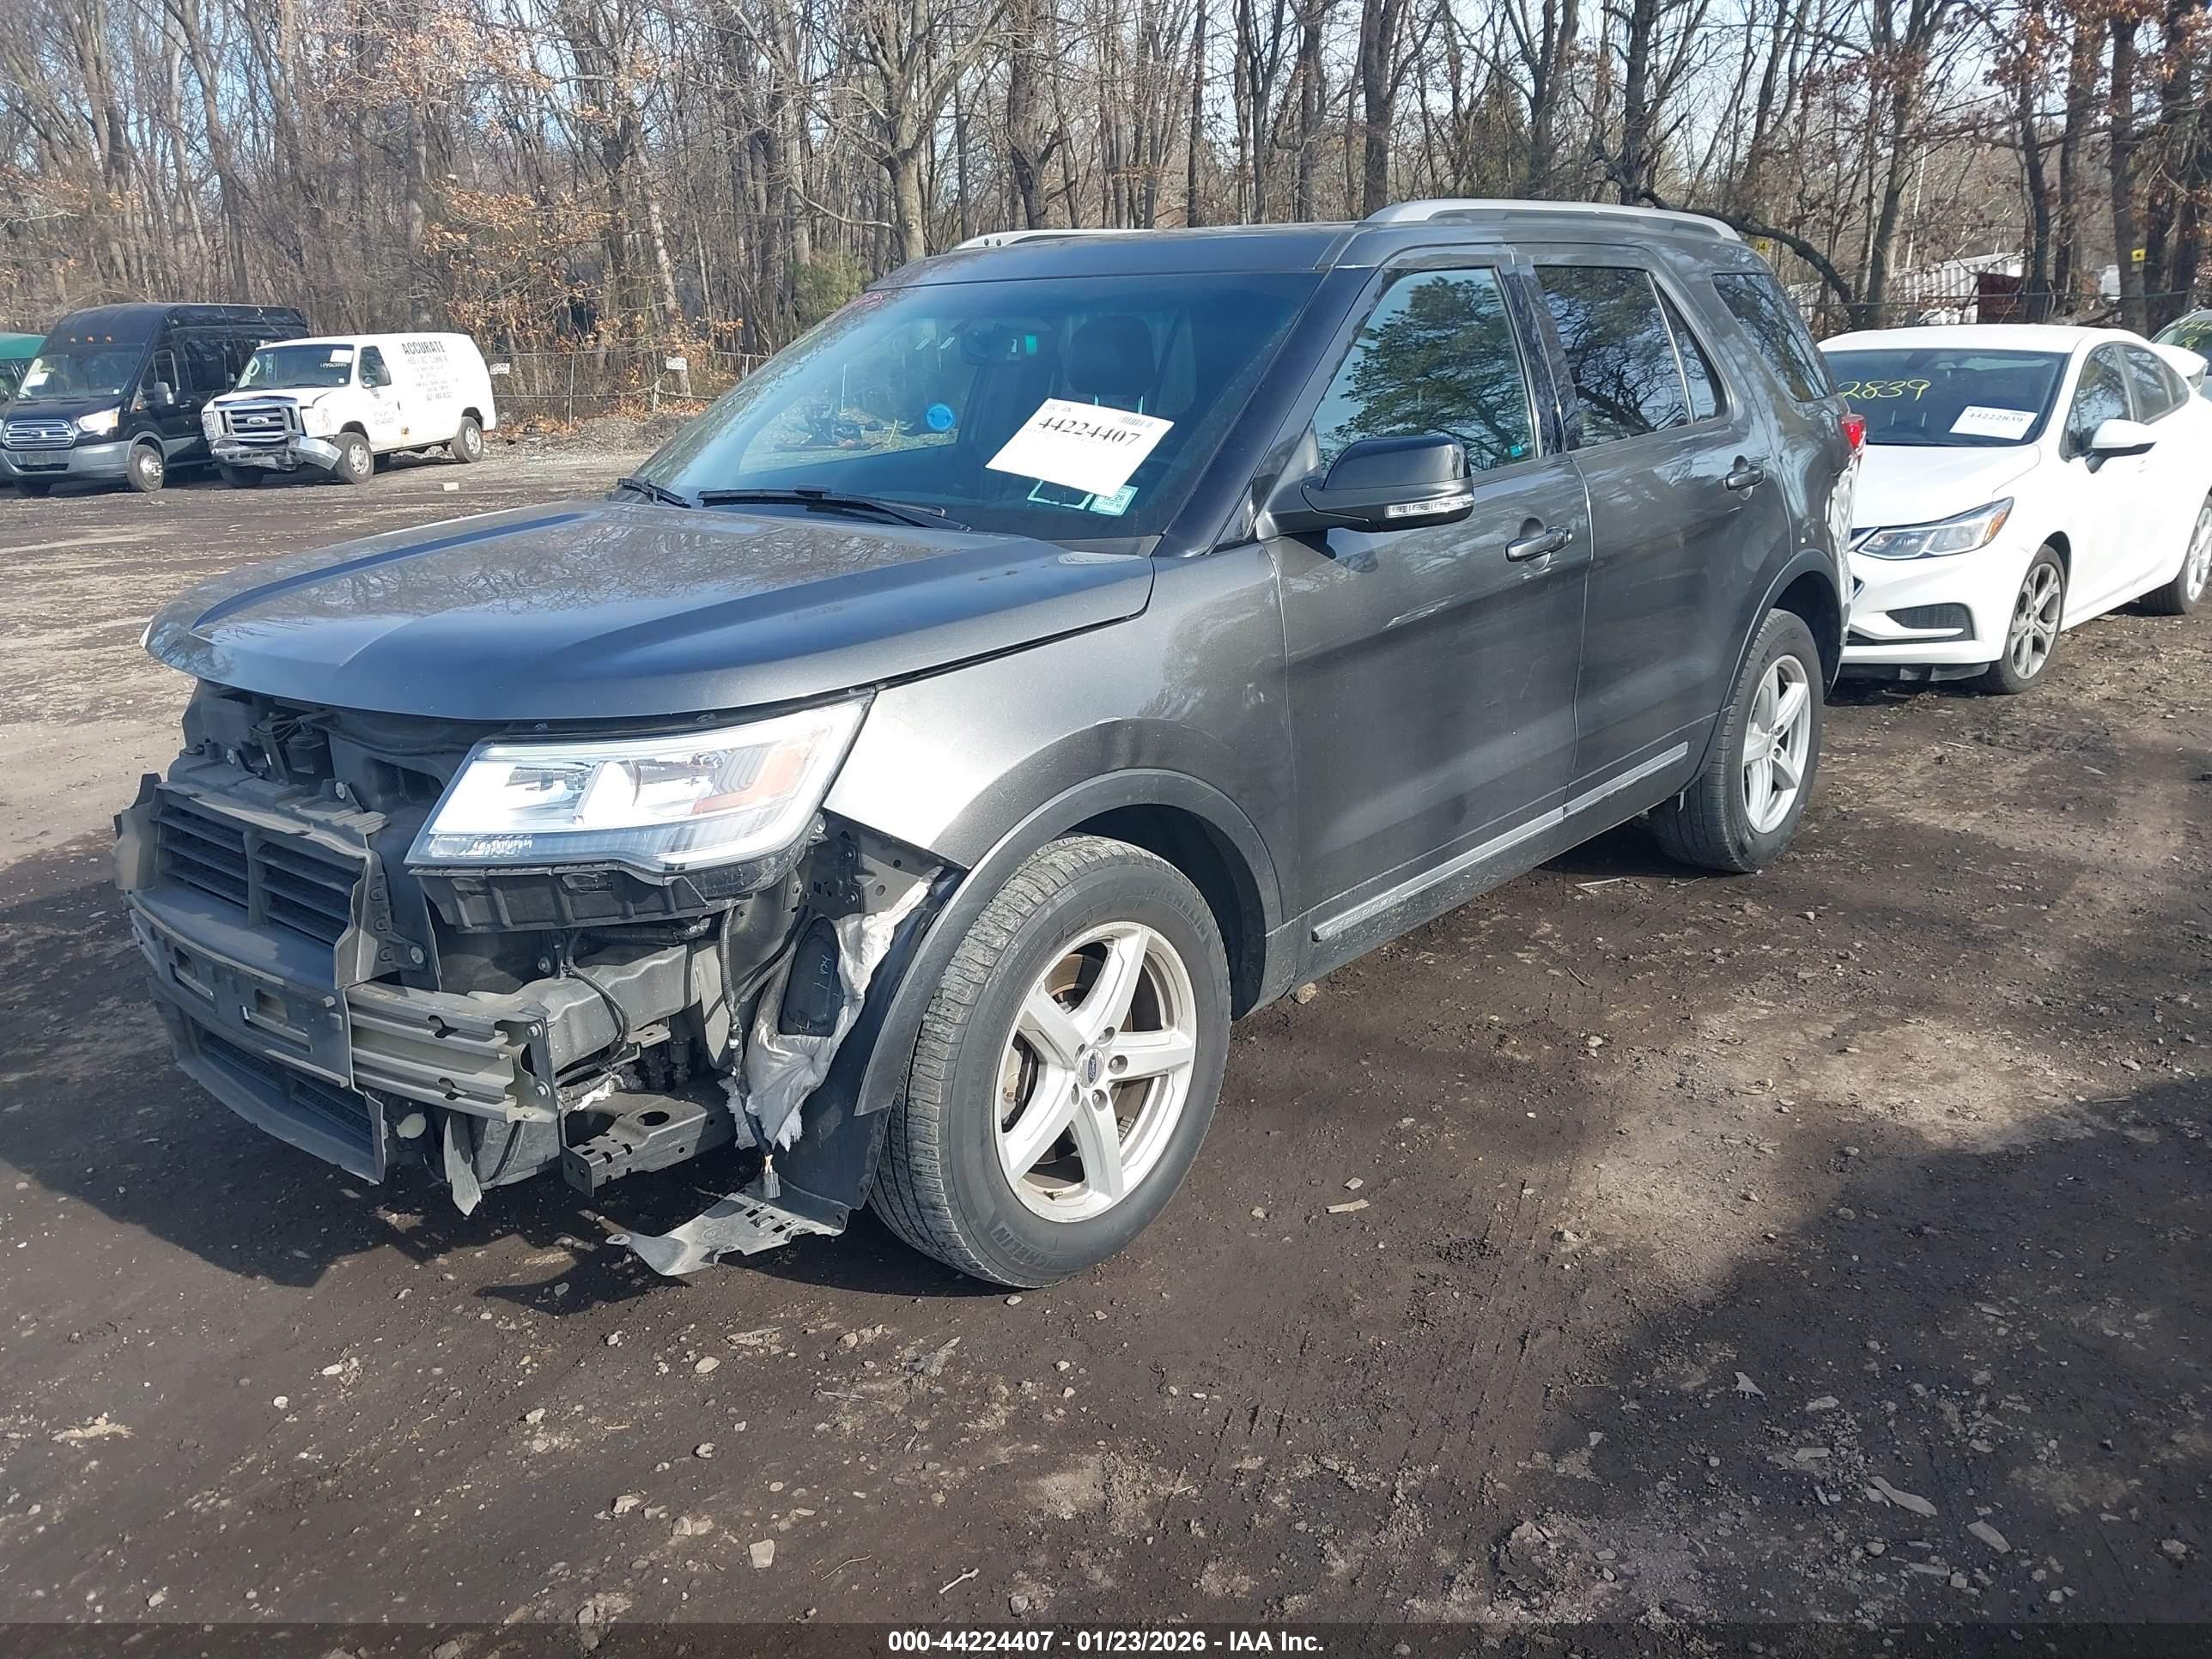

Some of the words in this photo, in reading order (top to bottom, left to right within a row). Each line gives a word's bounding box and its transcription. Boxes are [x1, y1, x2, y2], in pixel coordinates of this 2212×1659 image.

[401, 340, 446, 356] ACCURATE
[1838, 379, 1931, 401] 2839
[1038, 416, 1141, 447] 44224407
